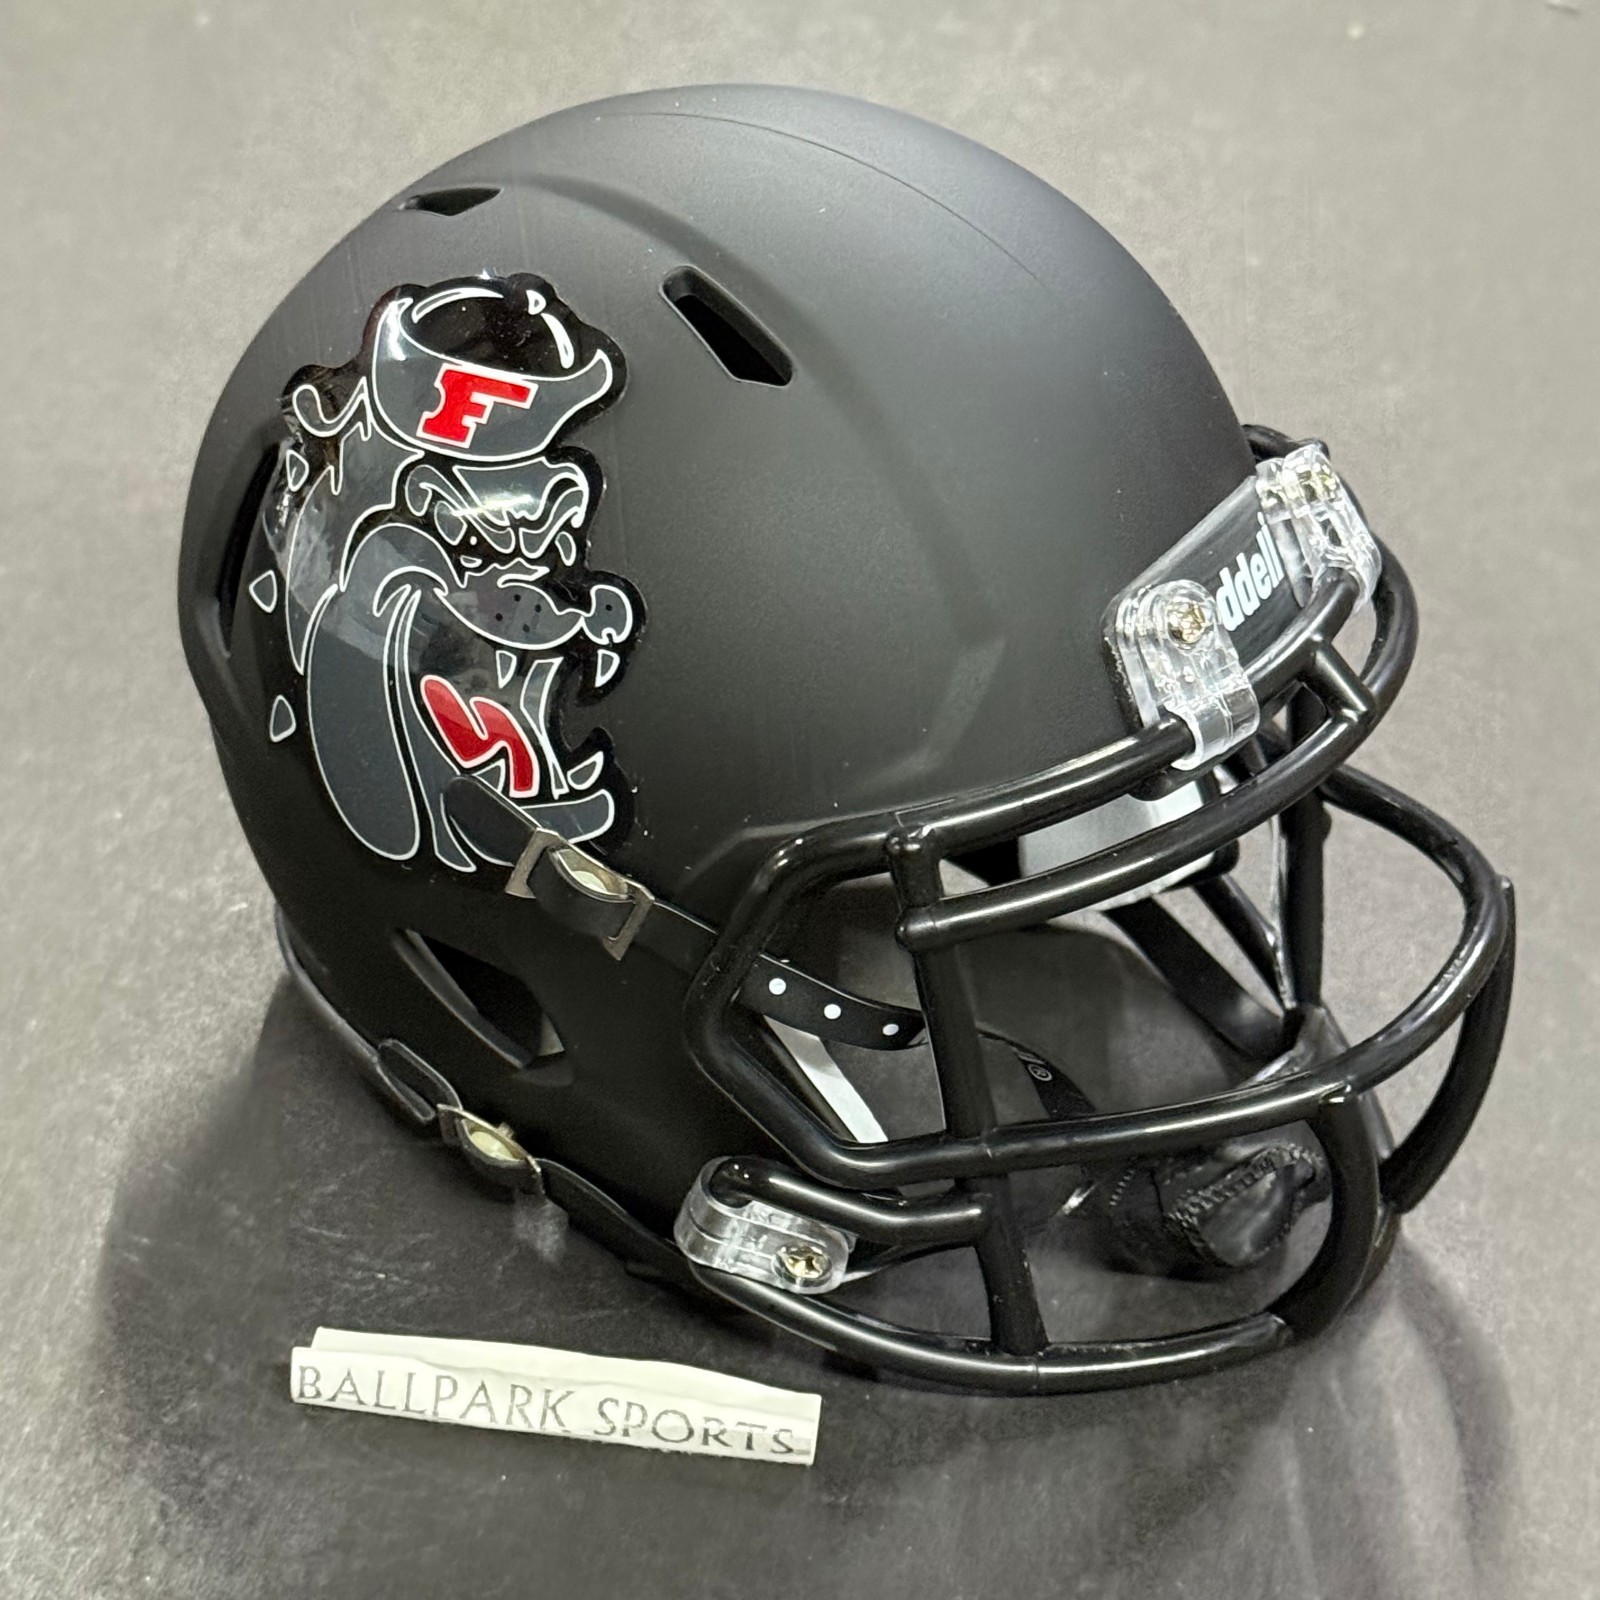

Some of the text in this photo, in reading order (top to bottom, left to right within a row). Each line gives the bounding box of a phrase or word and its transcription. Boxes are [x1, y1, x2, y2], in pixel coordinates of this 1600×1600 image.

[417, 363, 539, 449] F
[1213, 523, 1285, 632] ddell
[298, 1365, 796, 1455] BALLPARK SPORTS
